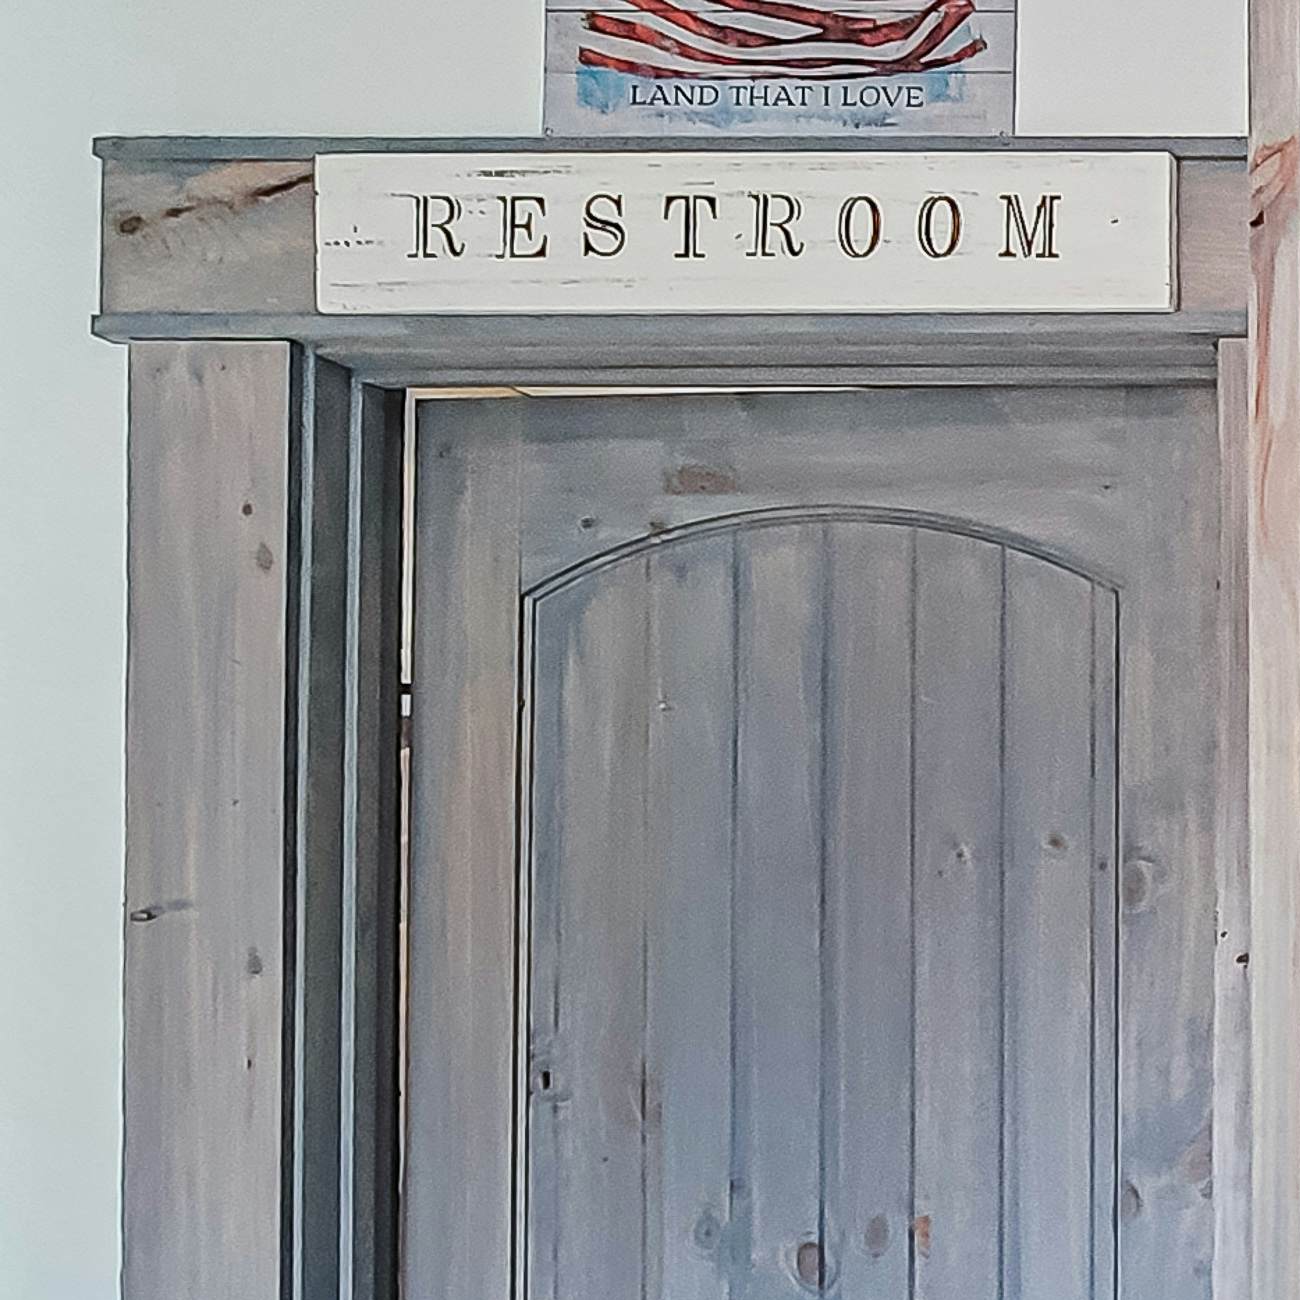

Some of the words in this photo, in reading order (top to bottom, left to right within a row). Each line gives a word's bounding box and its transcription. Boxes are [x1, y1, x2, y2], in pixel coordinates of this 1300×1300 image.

[629, 84, 720, 108] LAND
[729, 84, 814, 108] THAT
[822, 84, 832, 108] I
[840, 85, 925, 109] LOVE
[406, 193, 1063, 259] RESTROOM
